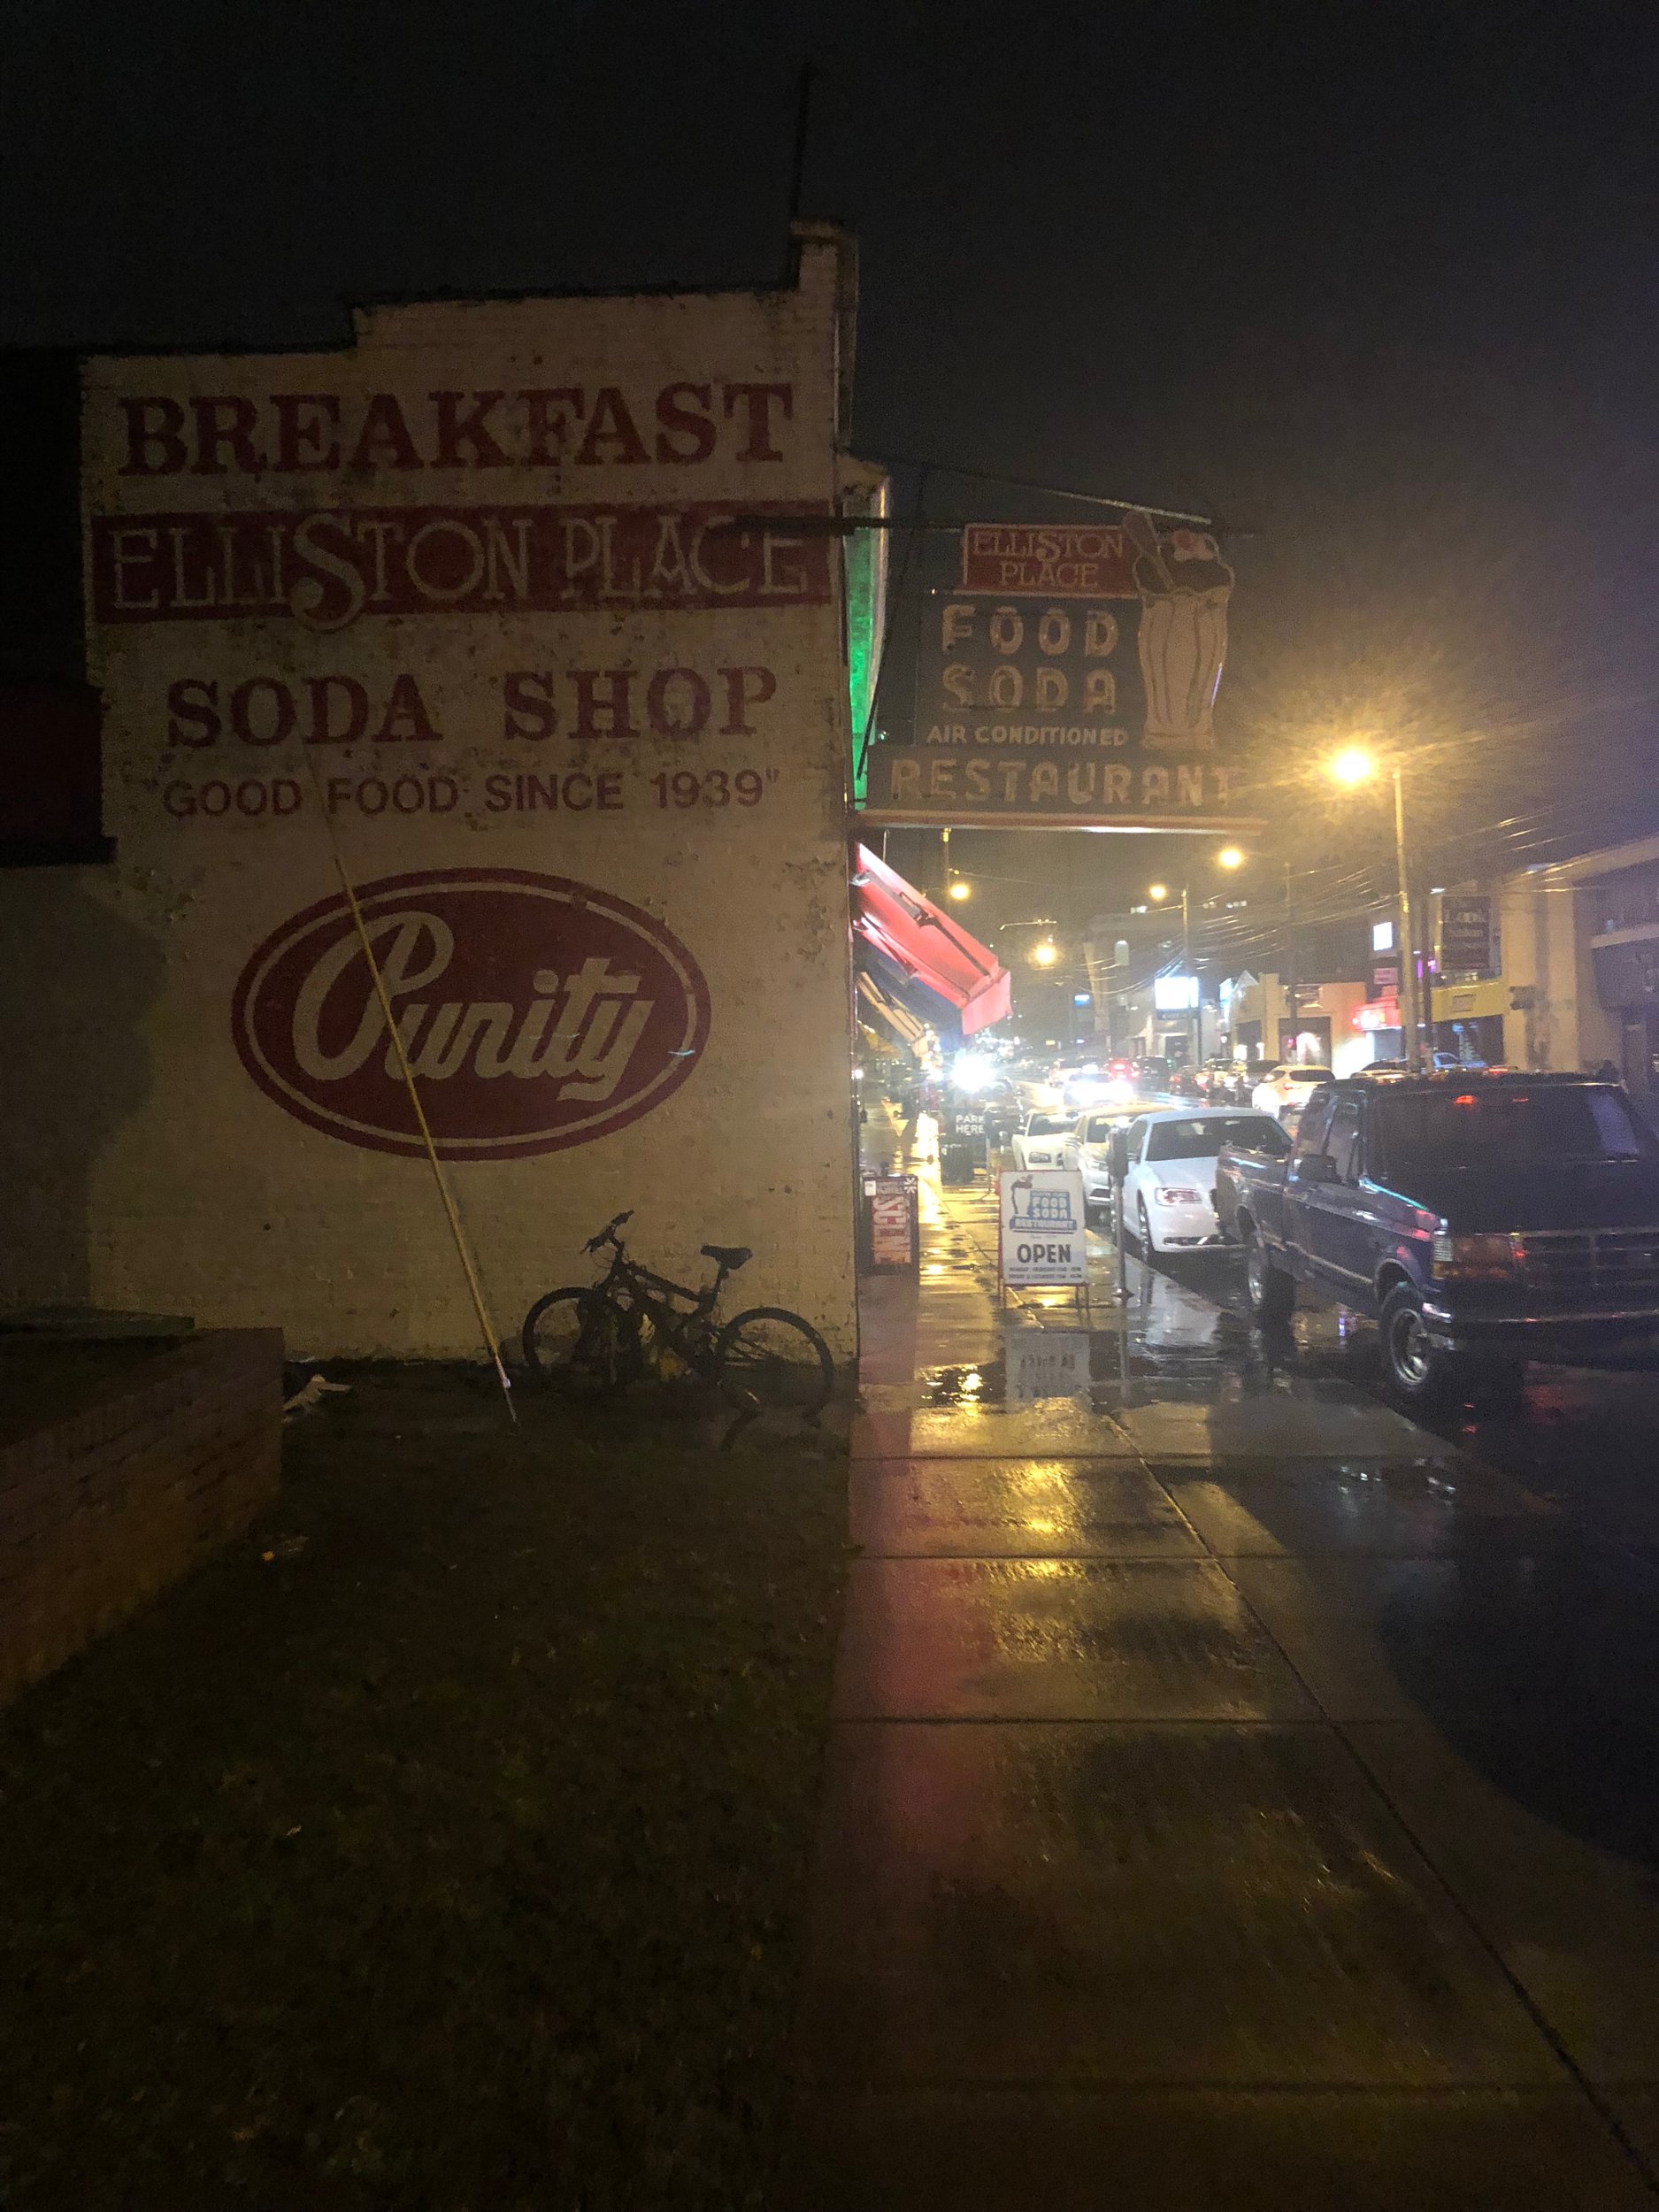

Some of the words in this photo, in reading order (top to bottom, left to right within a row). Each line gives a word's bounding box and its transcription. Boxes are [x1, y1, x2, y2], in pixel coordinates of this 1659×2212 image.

[119, 382, 794, 476] BREAKFAST
[973, 531, 1124, 564] ELLISTON
[113, 512, 534, 631] ELLISTON
[559, 513, 809, 600] PLACE
[999, 561, 1099, 589] PLACE
[941, 604, 1118, 657] FOOD
[167, 674, 443, 749] SODA
[504, 666, 777, 741] SHOP
[941, 663, 1117, 714] SODA
[926, 726, 967, 744] AIR
[975, 726, 1129, 747] CONDITIONED
[326, 775, 459, 815] FOOD
[486, 772, 624, 811] SINCE
[890, 758, 1246, 808] RESTAURANT
[291, 910, 655, 1102] Purity
[955, 1114, 986, 1124] PARK
[955, 1125, 986, 1133] HERE
[1032, 1196, 1068, 1209] FOOD
[1032, 1208, 1069, 1219] SODA
[1017, 1243, 1071, 1263] OPEN
